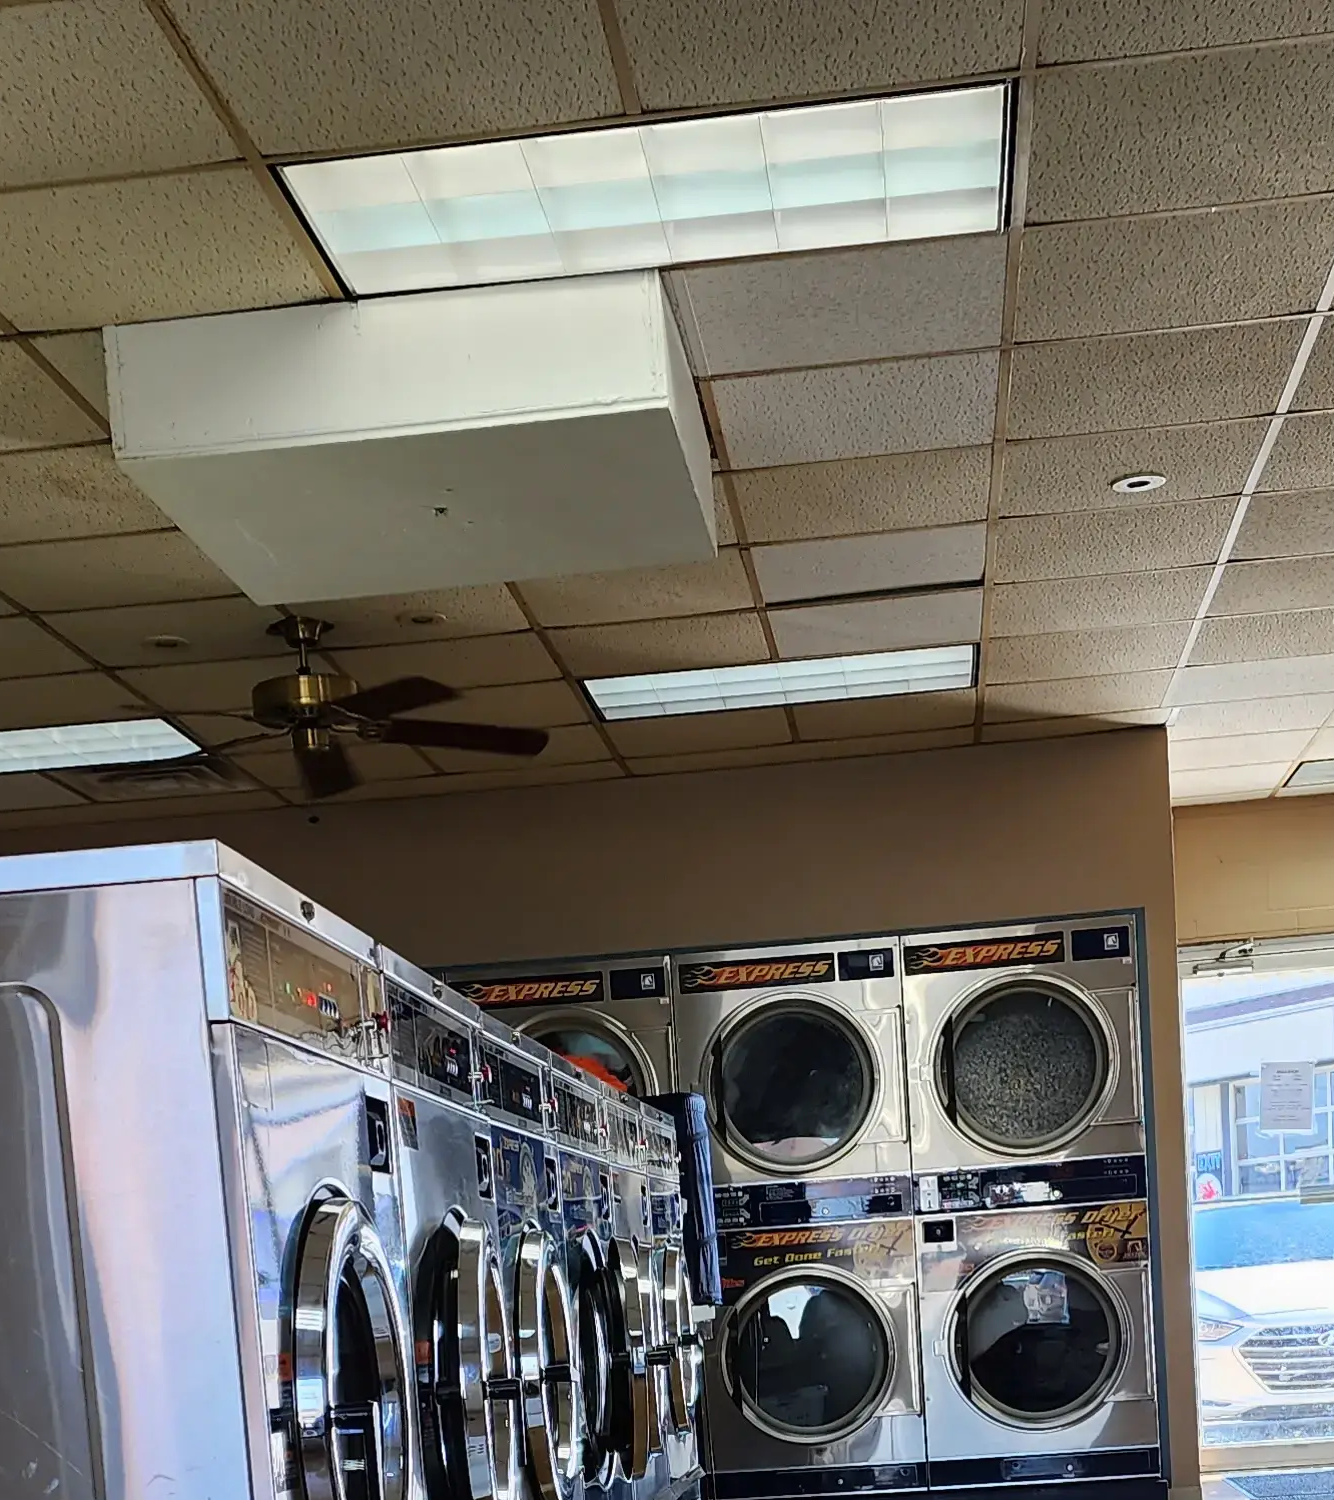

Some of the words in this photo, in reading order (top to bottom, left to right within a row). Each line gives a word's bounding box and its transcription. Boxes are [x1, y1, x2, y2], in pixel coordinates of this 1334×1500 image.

[945, 938, 1062, 965] EXPRESS
[716, 960, 833, 984] EXPRESS
[487, 979, 600, 1002] EXPRESS
[756, 1226, 844, 1248] EXPRESS
[753, 1254, 780, 1267] Get
[784, 1252, 822, 1264] Done
